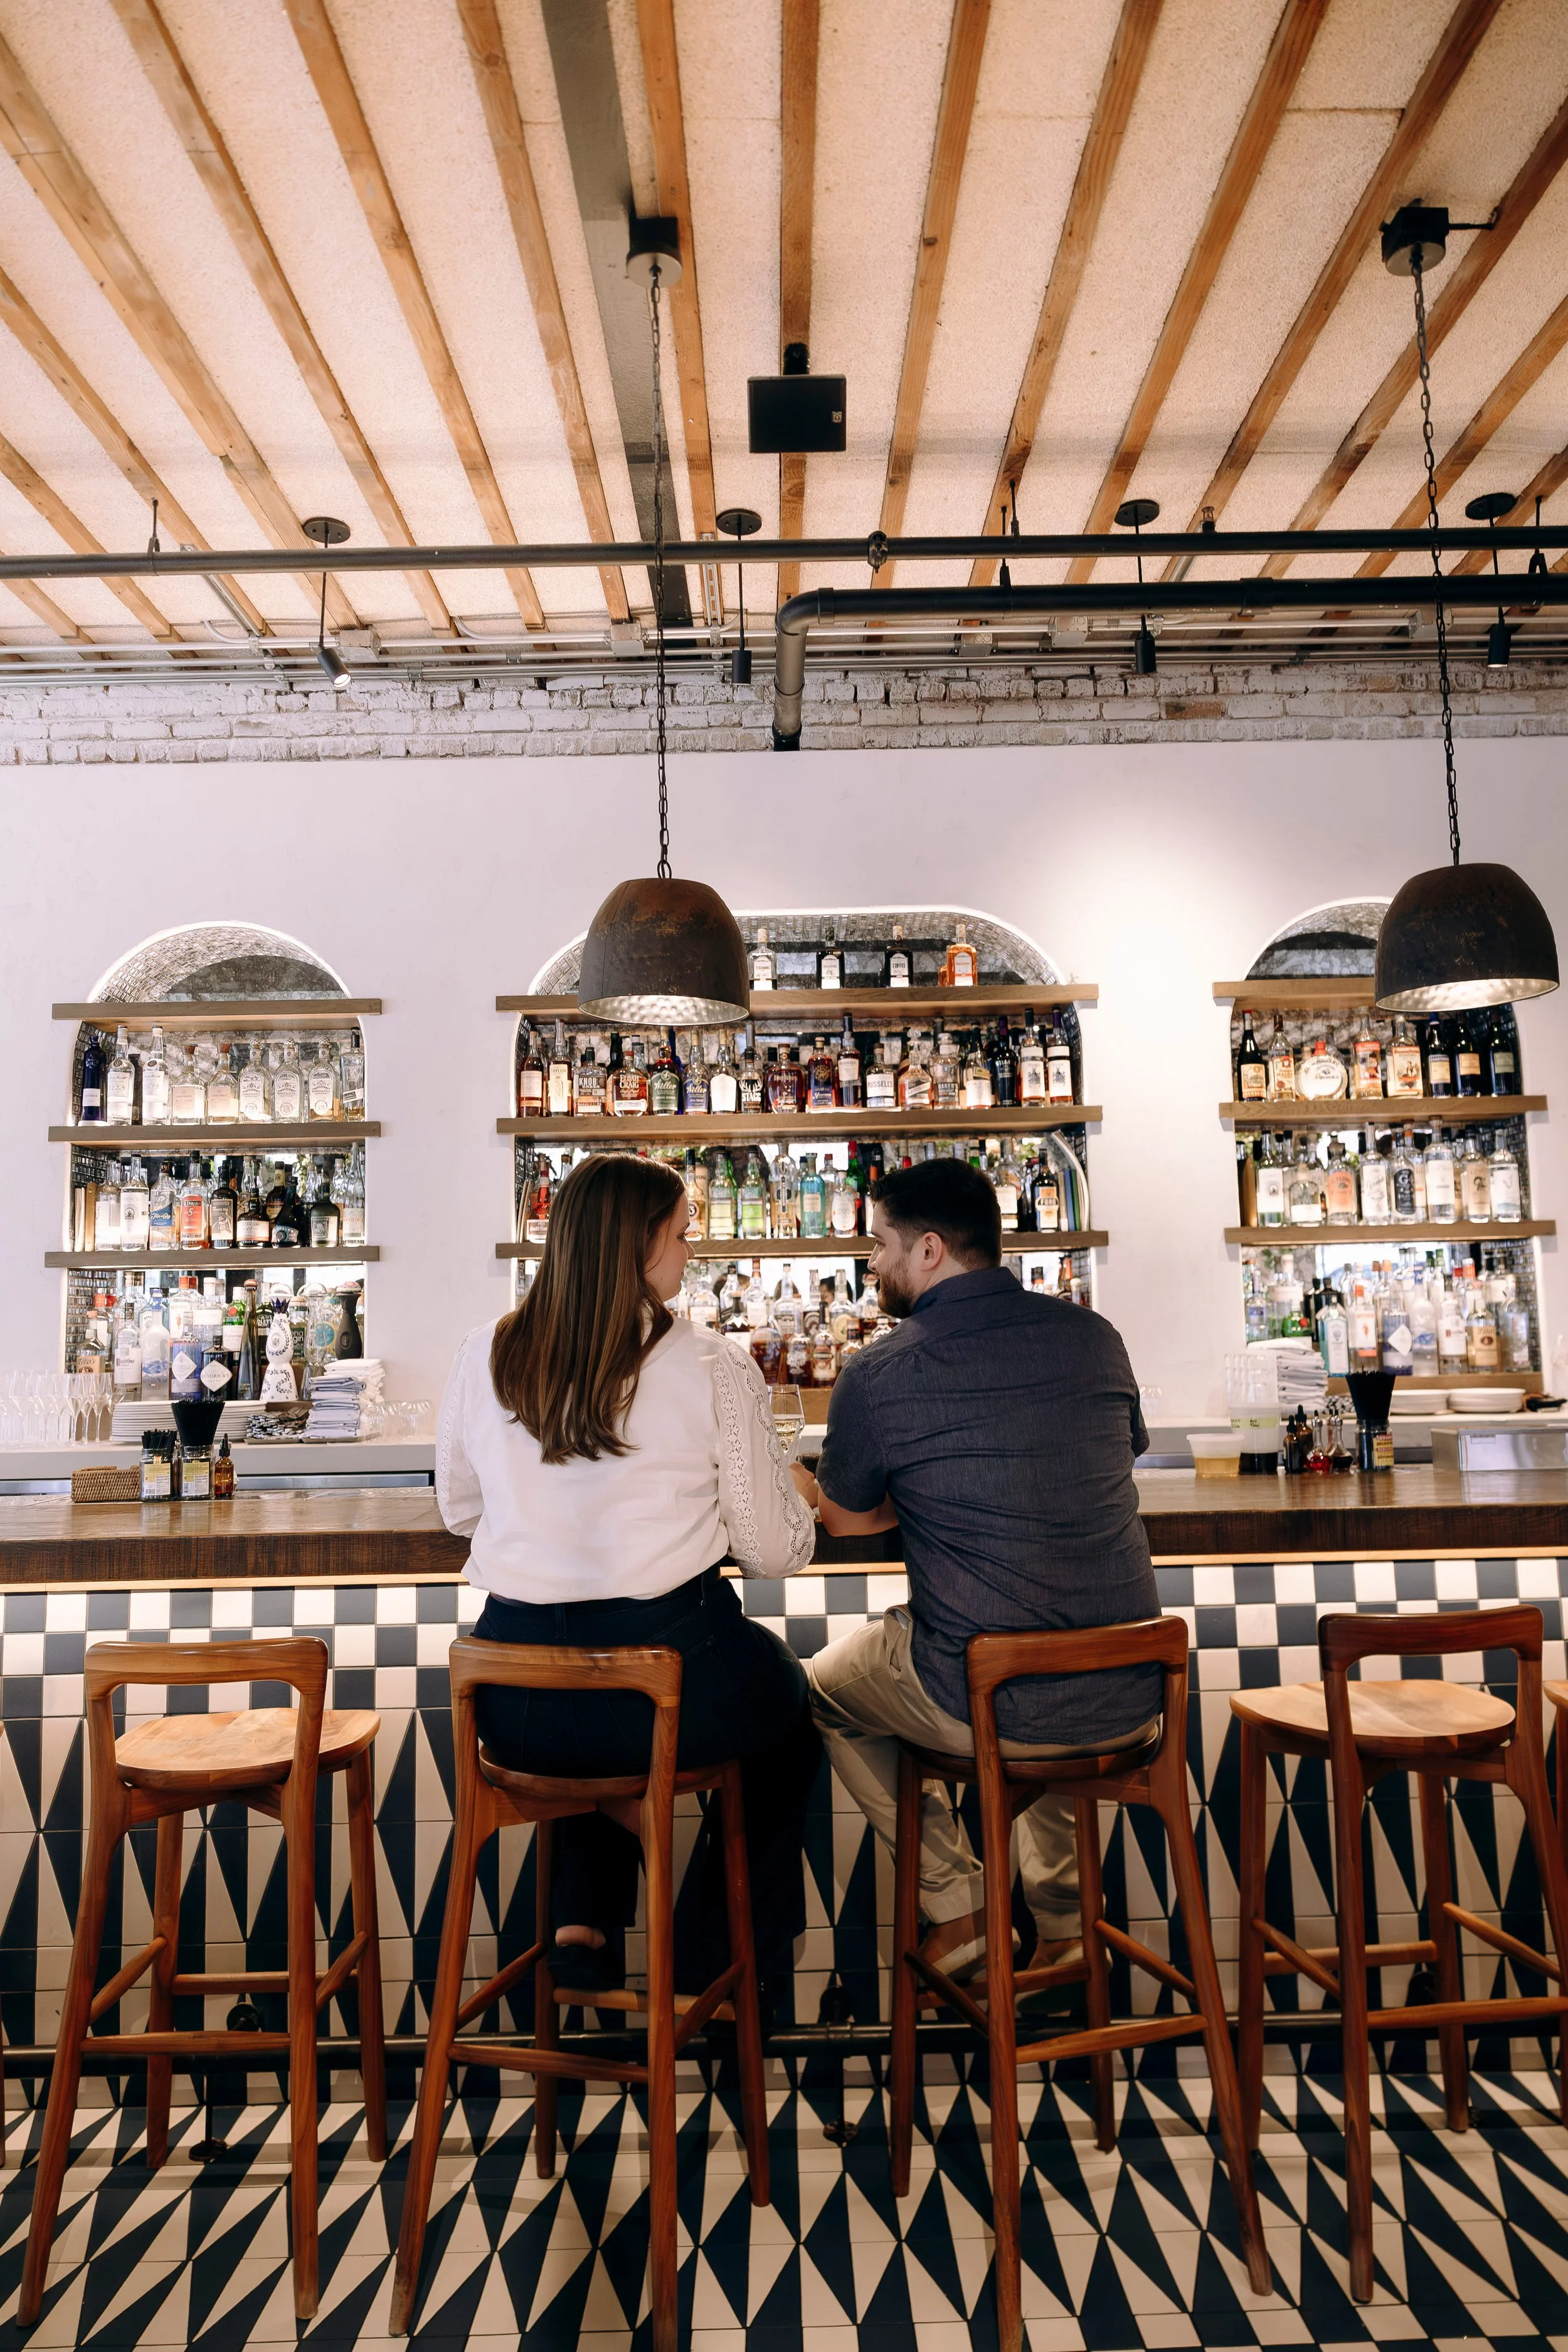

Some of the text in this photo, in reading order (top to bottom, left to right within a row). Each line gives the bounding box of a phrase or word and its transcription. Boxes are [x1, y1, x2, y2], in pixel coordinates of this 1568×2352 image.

[579, 1078, 596, 1086] KNOB
[620, 1074, 639, 1083] ELIJAH
[654, 1081, 677, 1090] Weller
[686, 1083, 707, 1094] Weller
[741, 1092, 761, 1102] STAGG
[188, 1207, 194, 1217] 5
